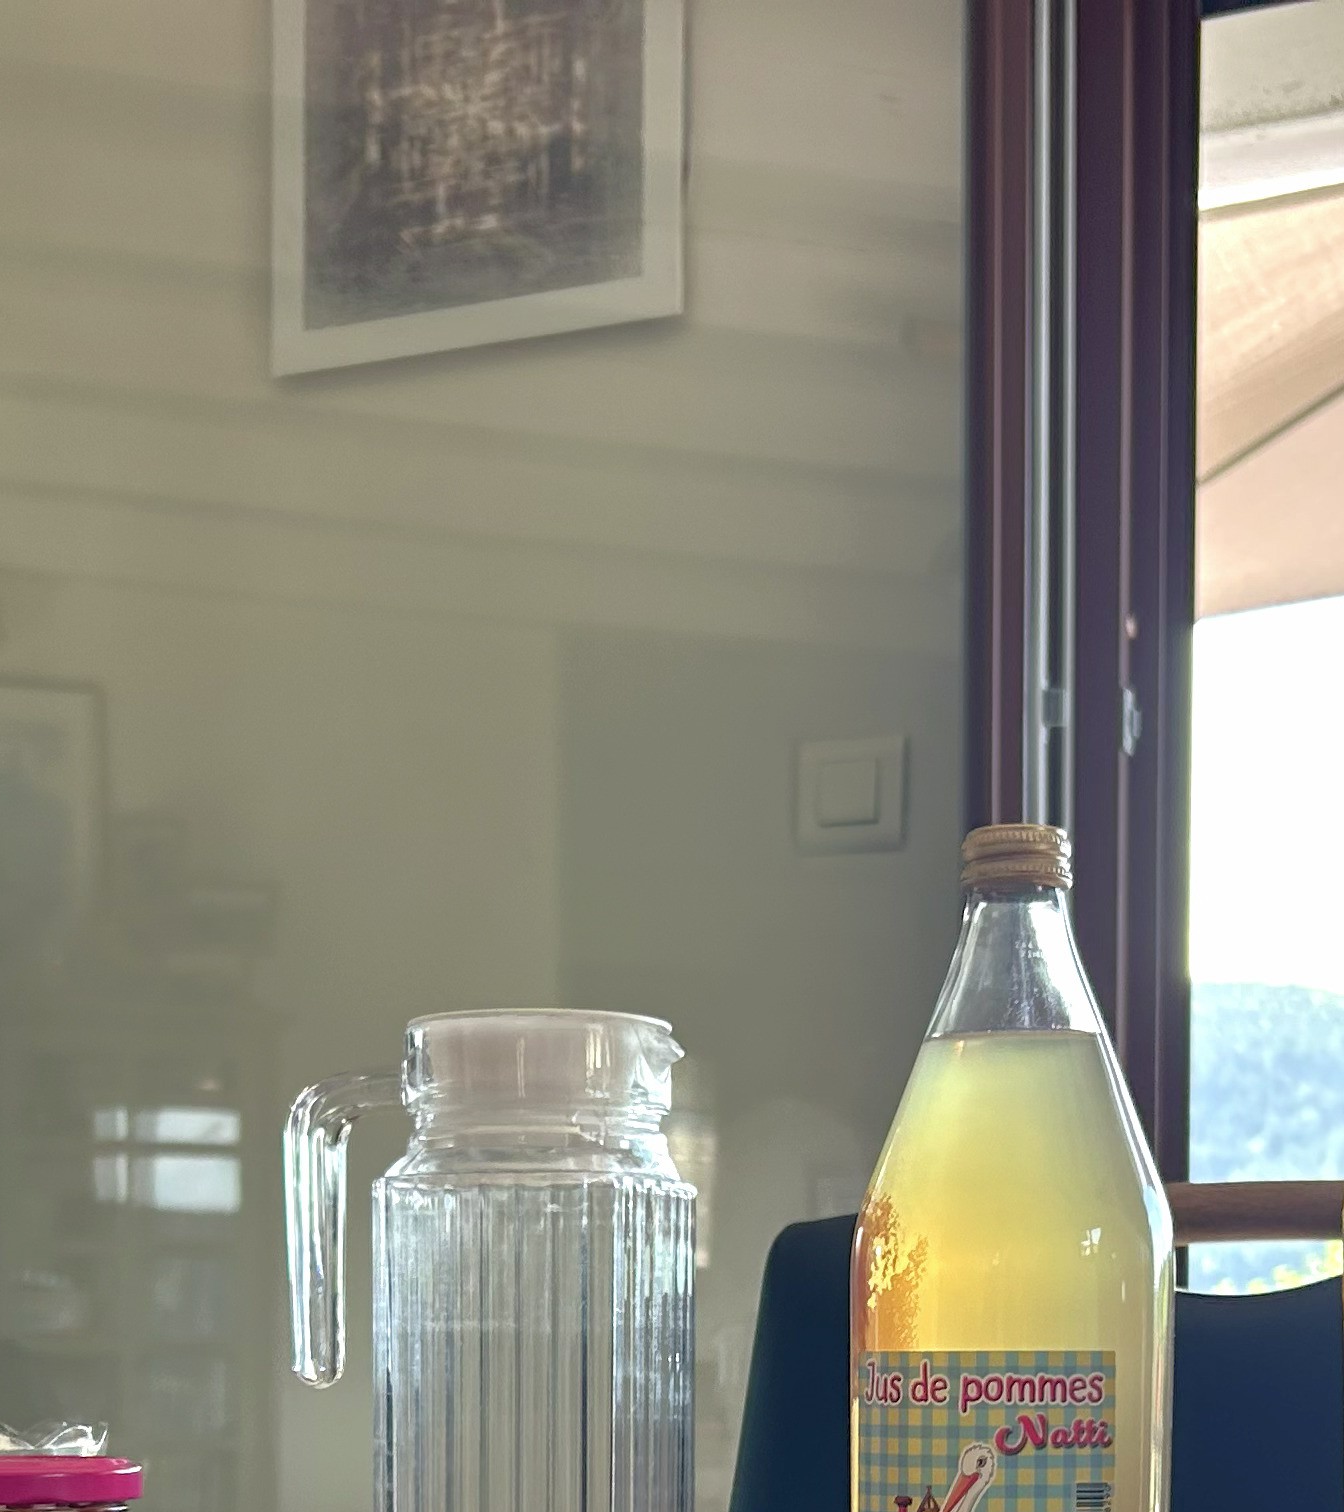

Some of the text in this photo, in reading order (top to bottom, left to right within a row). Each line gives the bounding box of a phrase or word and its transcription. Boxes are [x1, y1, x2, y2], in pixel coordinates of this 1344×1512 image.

[865, 1360, 1105, 1414] Jus de pommes
[994, 1413, 1113, 1455] Natti
